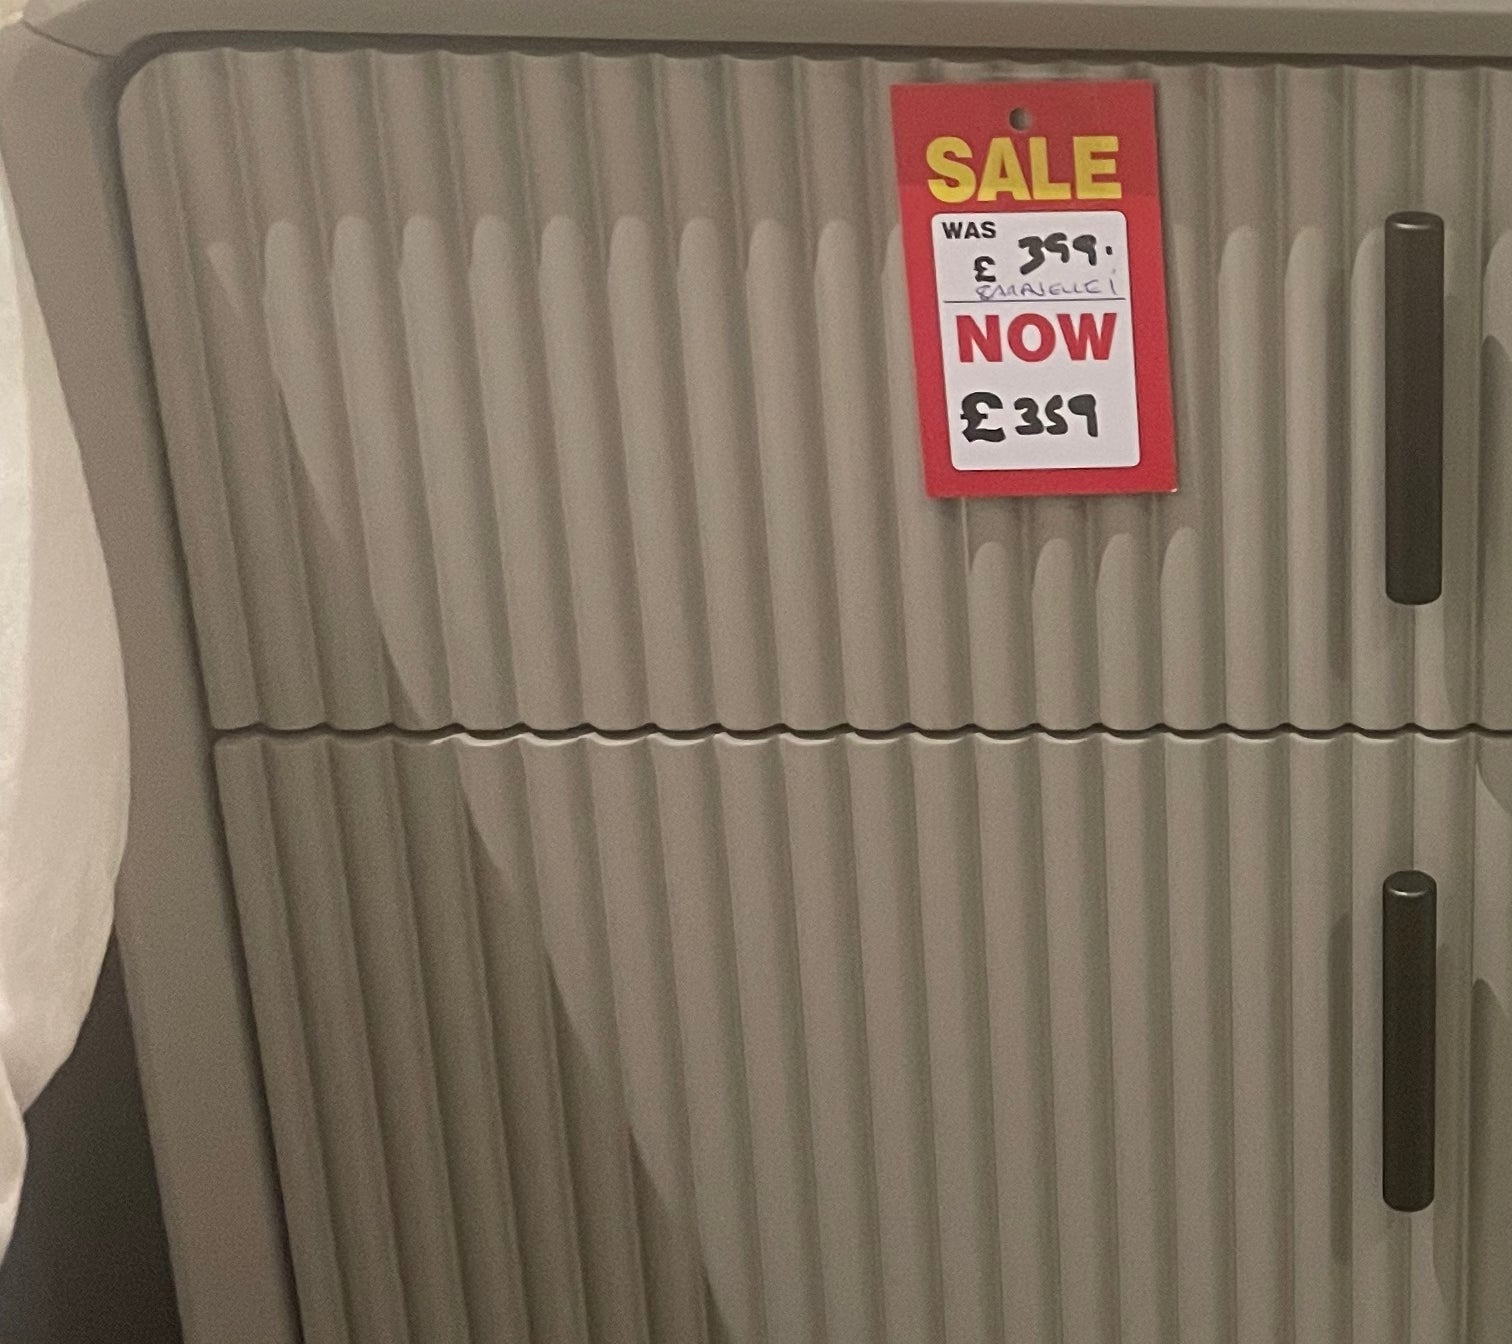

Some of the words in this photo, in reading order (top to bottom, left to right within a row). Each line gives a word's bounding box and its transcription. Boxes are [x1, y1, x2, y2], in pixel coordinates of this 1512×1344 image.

[926, 136, 1122, 203] SALE
[942, 221, 997, 240] WAS
[956, 312, 1117, 363] NOW
